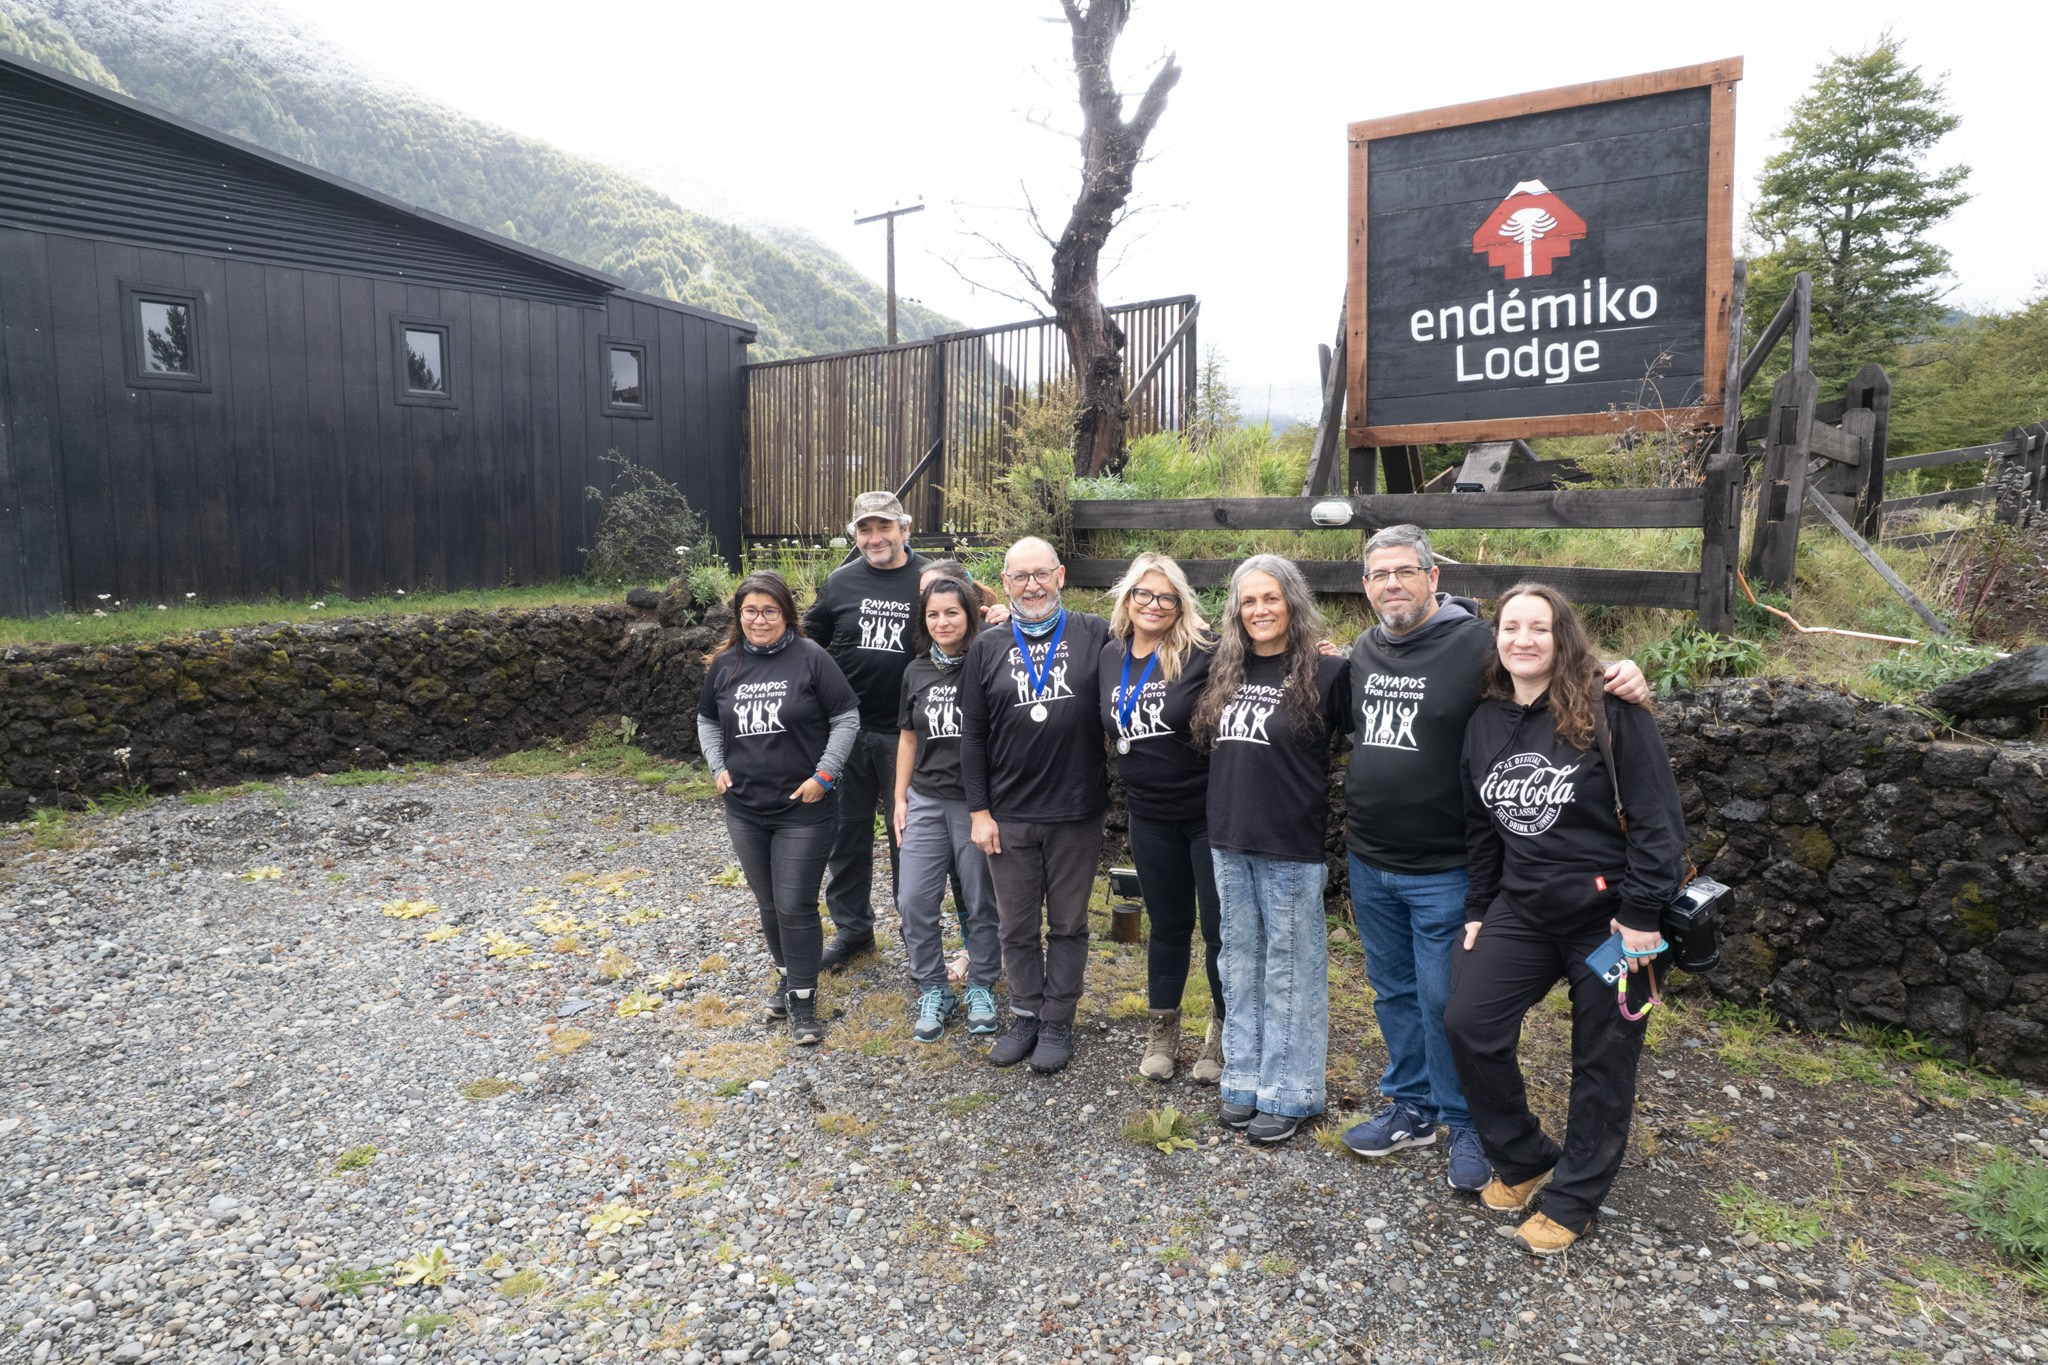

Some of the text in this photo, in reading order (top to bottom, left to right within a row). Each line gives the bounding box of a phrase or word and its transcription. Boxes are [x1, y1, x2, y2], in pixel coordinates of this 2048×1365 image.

[1411, 276, 1657, 341] endémiko
[1456, 338, 1600, 384] Lodge
[891, 611, 910, 619] FOTOS
[1369, 689, 1425, 700] POR LAS FOTOS
[1257, 696, 1281, 705] FOTOS
[1514, 756, 1542, 766] OFFICIAL
[1509, 807, 1540, 817] CLASSIC
[1496, 807, 1557, 833] SOFT DRINK OF SUMMER
